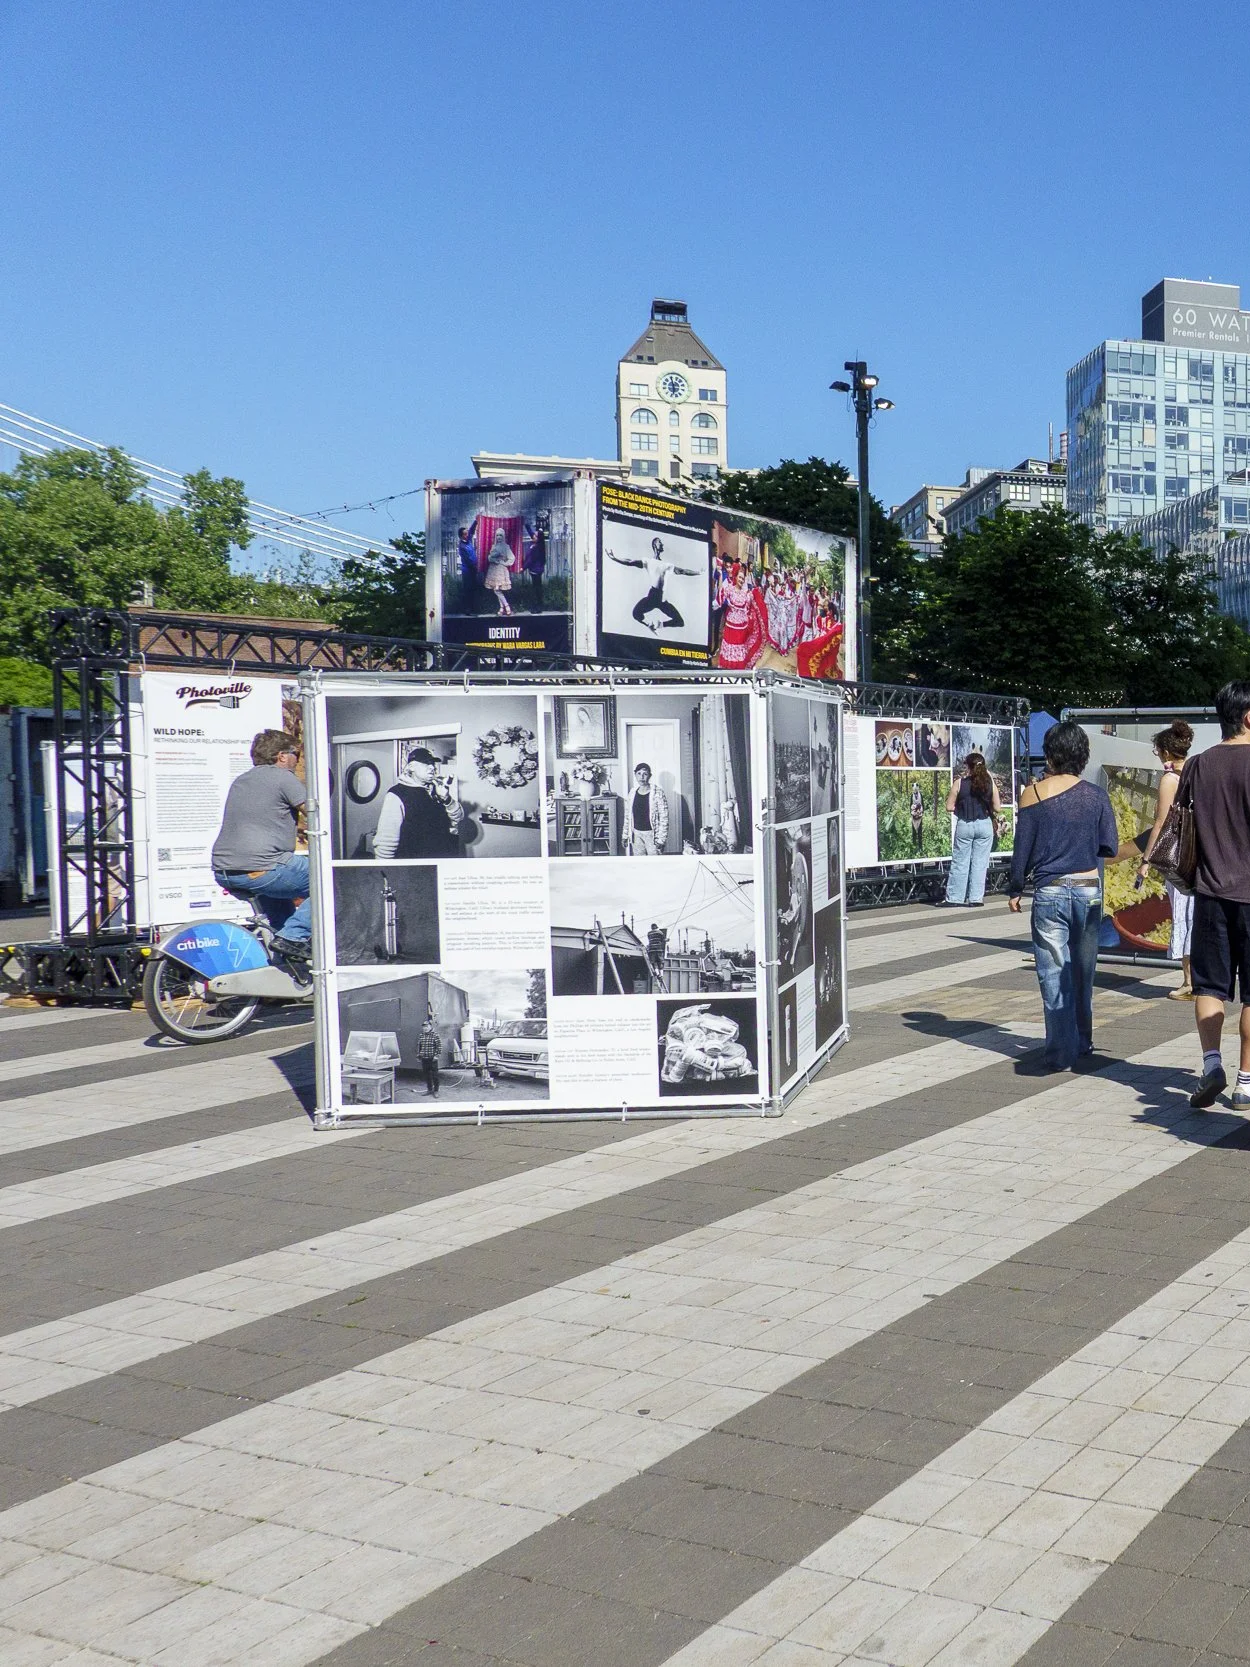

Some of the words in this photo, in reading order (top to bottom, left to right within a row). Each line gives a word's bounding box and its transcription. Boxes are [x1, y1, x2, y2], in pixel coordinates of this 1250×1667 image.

[1173, 308, 1197, 325] 60
[1173, 327, 1206, 338] Premier
[1209, 332, 1240, 342] Rentals
[602, 486, 618, 496] POSE:
[618, 490, 635, 501] BLACK
[634, 494, 652, 505] DANCE
[652, 499, 686, 514] PHOTOGRAPHY
[602, 496, 618, 506] FROM
[617, 500, 628, 508] THE
[653, 507, 674, 519] CENTURY
[488, 627, 520, 639] IDENTITY
[176, 682, 251, 699] Photoville
